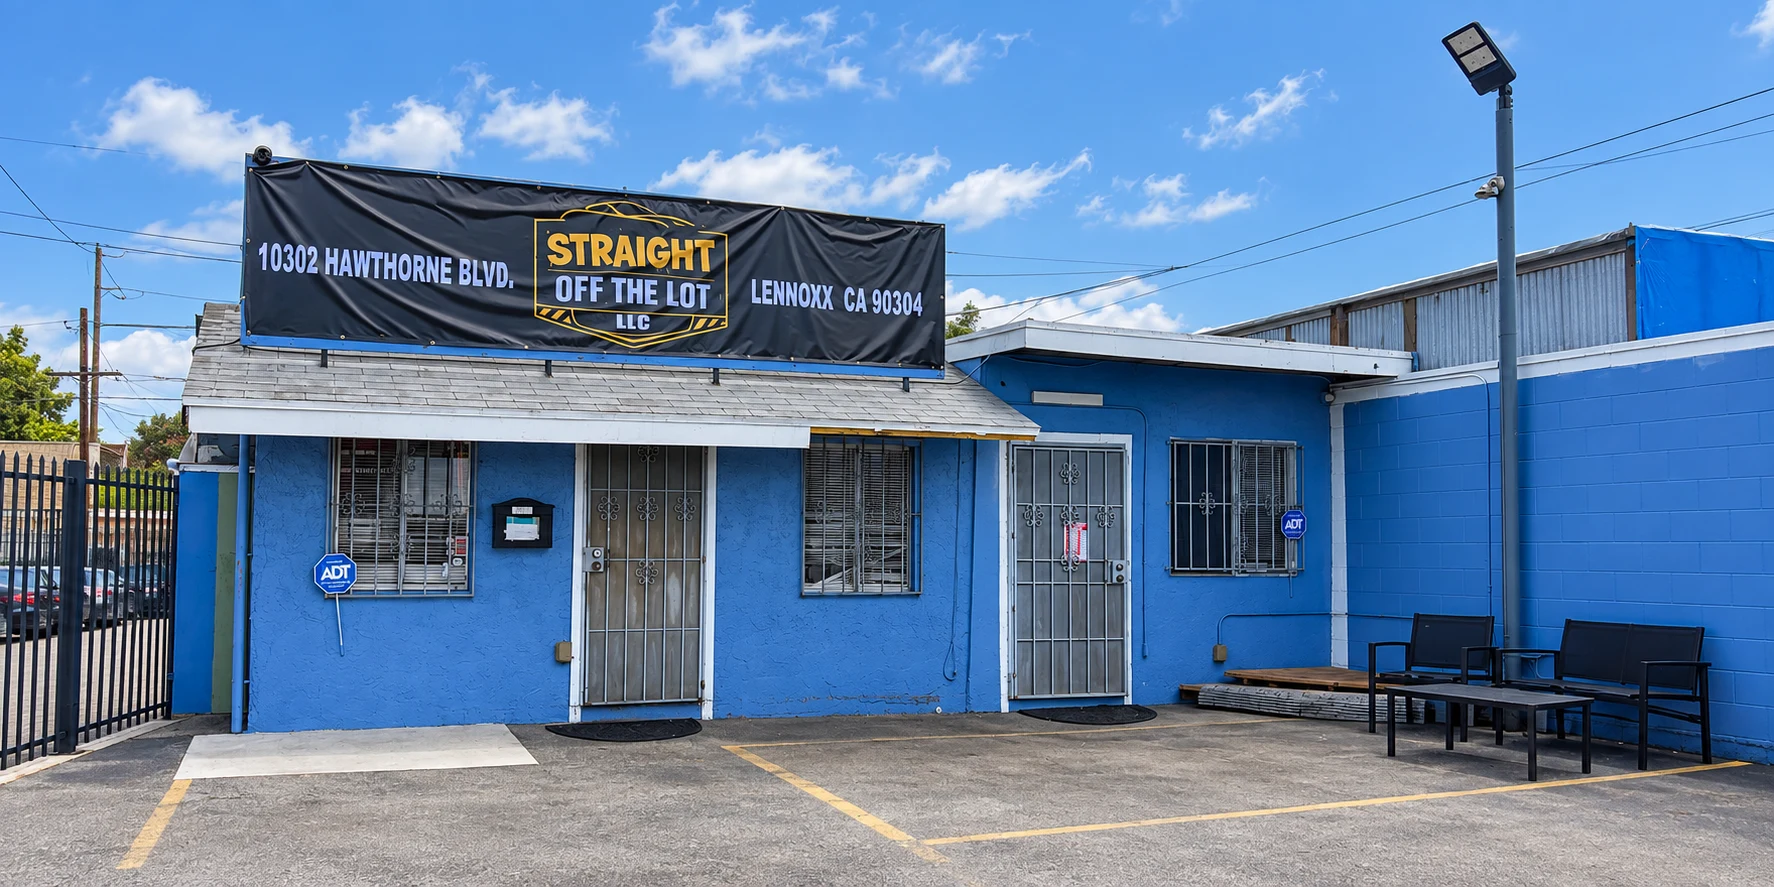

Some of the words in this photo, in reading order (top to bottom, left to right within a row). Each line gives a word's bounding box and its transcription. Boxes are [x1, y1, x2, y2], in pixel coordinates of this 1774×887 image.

[258, 243, 318, 274] 10302
[325, 247, 453, 284] HAWTHORNE
[458, 258, 514, 289] BLVD.
[547, 233, 715, 272] STRAIGHT
[555, 275, 603, 303] OFF
[611, 277, 658, 305] THE
[666, 281, 711, 309] LOT
[751, 278, 834, 311] LENNOXX
[844, 286, 867, 313] CA
[872, 288, 923, 316] 90304
[616, 314, 650, 330] LLC
[1284, 518, 1303, 530] ADT
[320, 564, 351, 581] ADT
